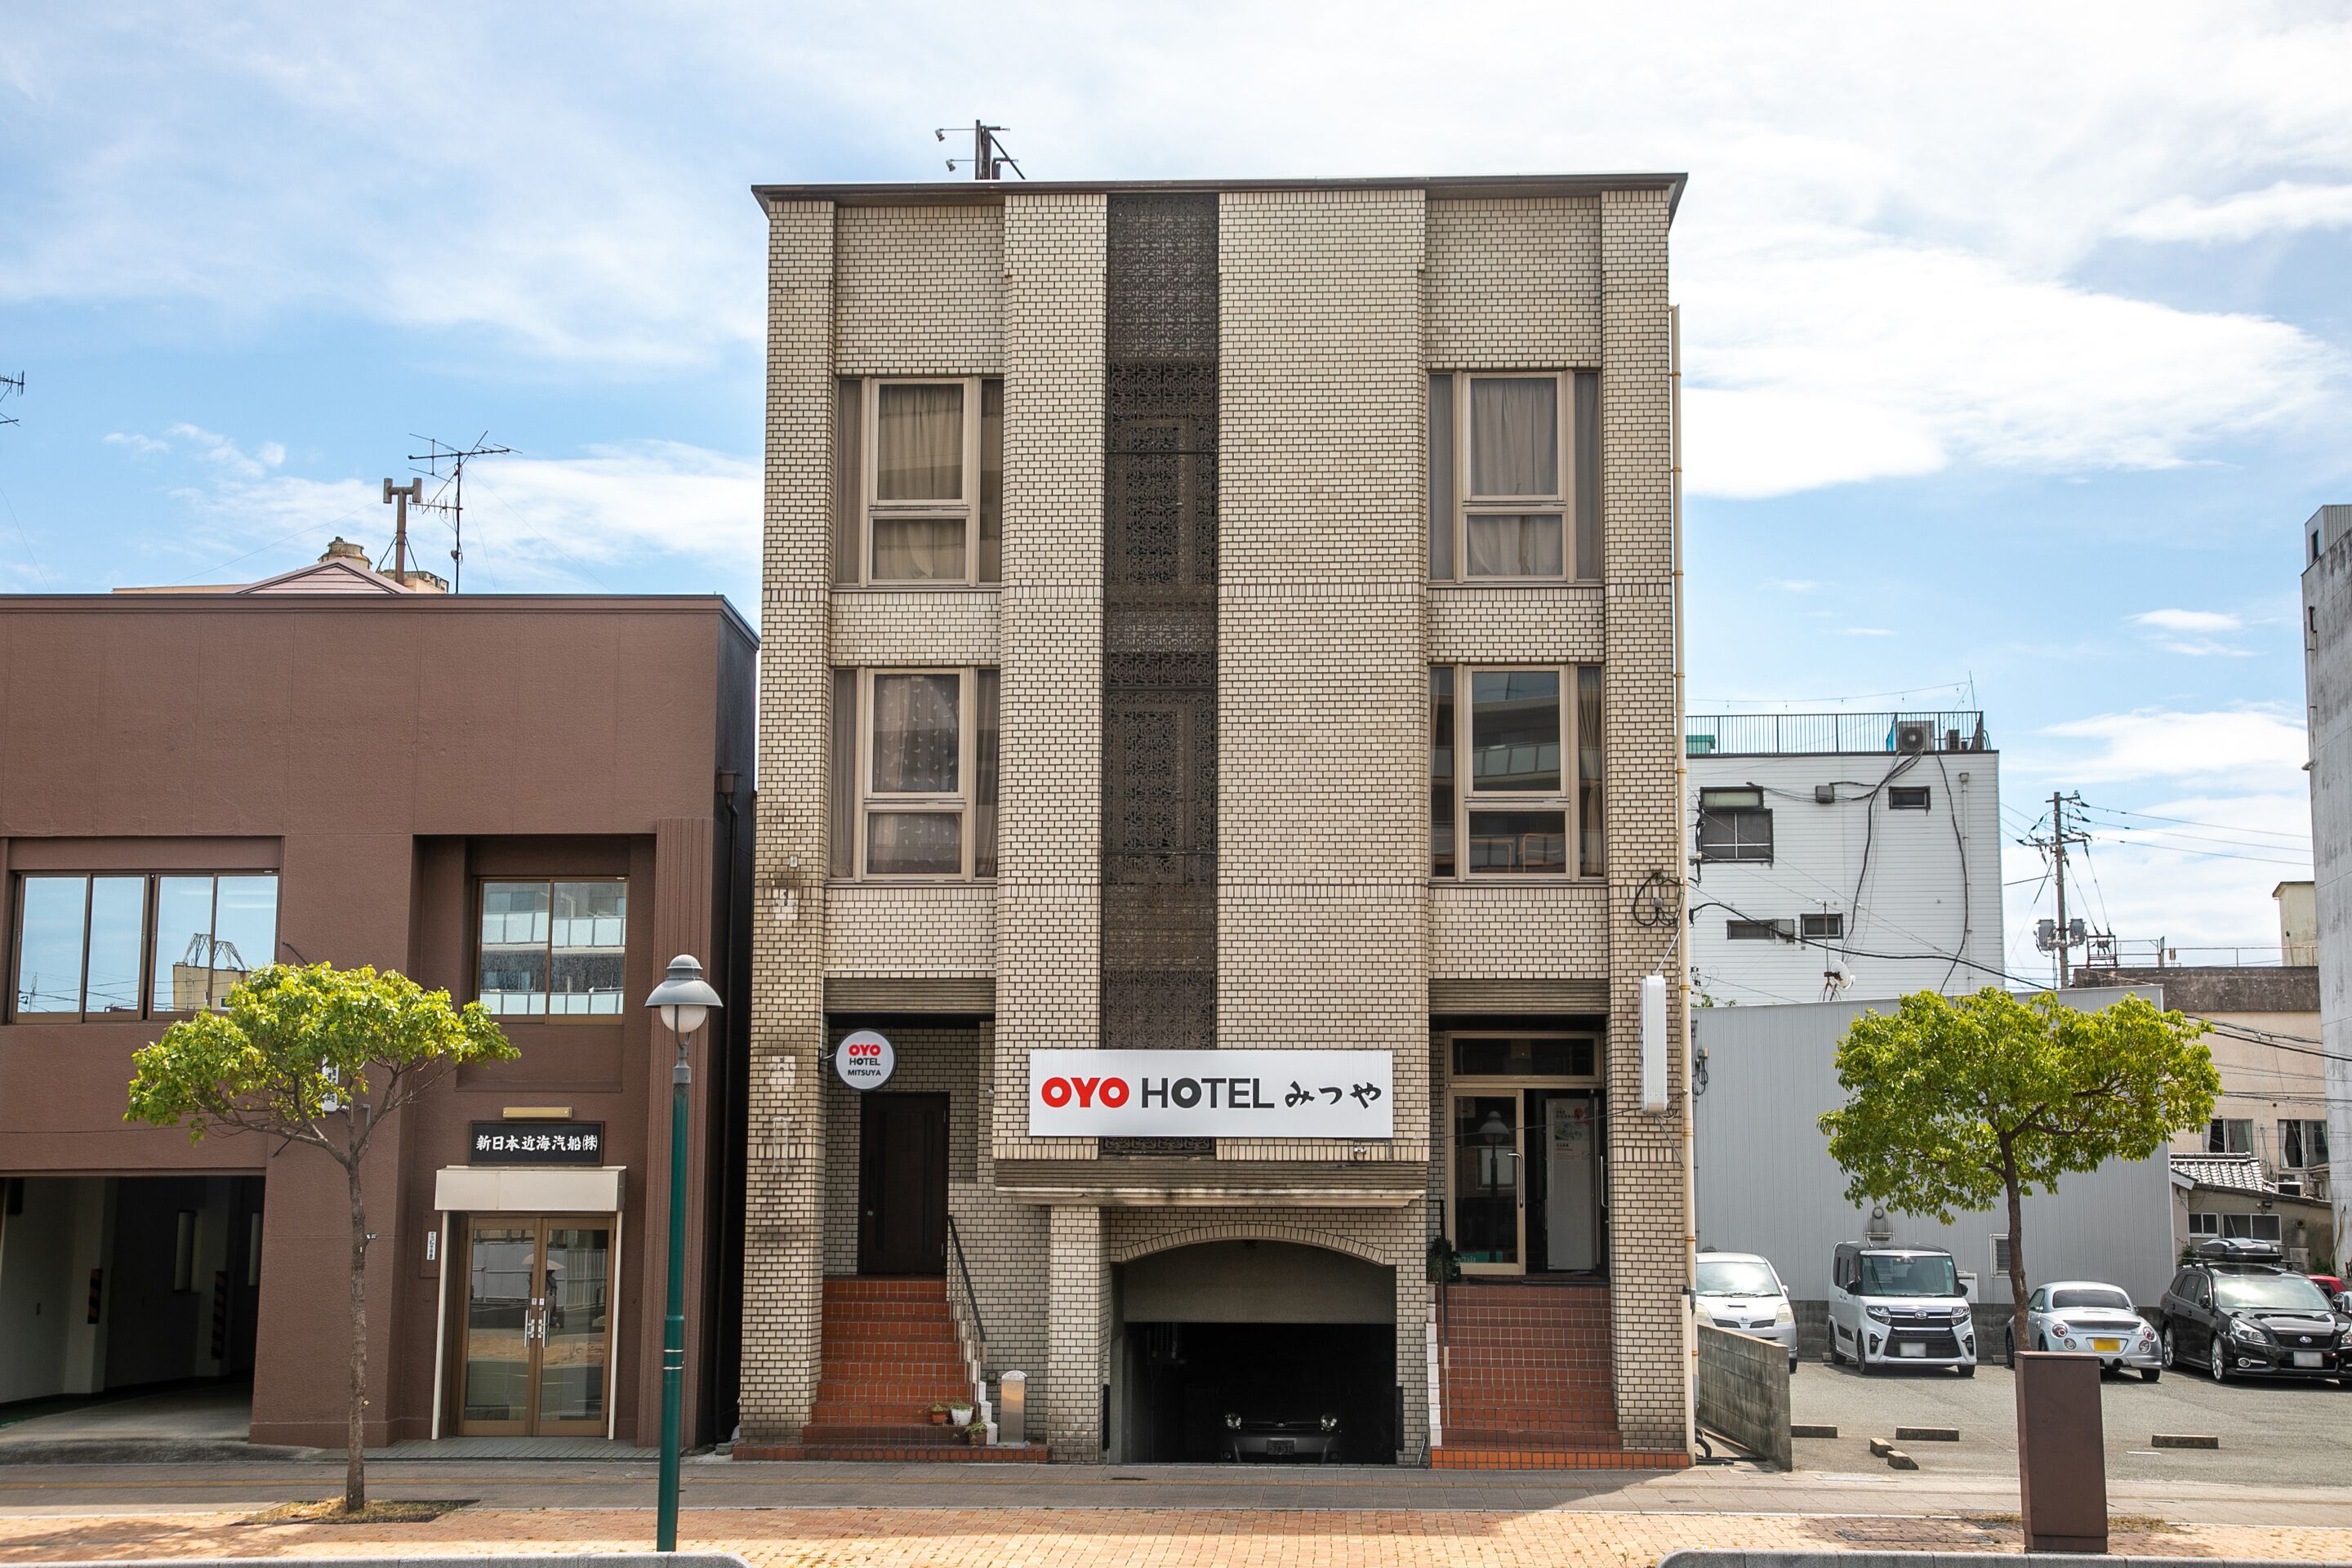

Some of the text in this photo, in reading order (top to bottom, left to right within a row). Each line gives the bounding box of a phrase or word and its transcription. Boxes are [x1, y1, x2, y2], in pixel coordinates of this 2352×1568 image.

[849, 1045, 881, 1056] OYO
[849, 1058, 881, 1066] HOTEL
[1041, 1076, 1382, 1109] OYO HOTEL みつや
